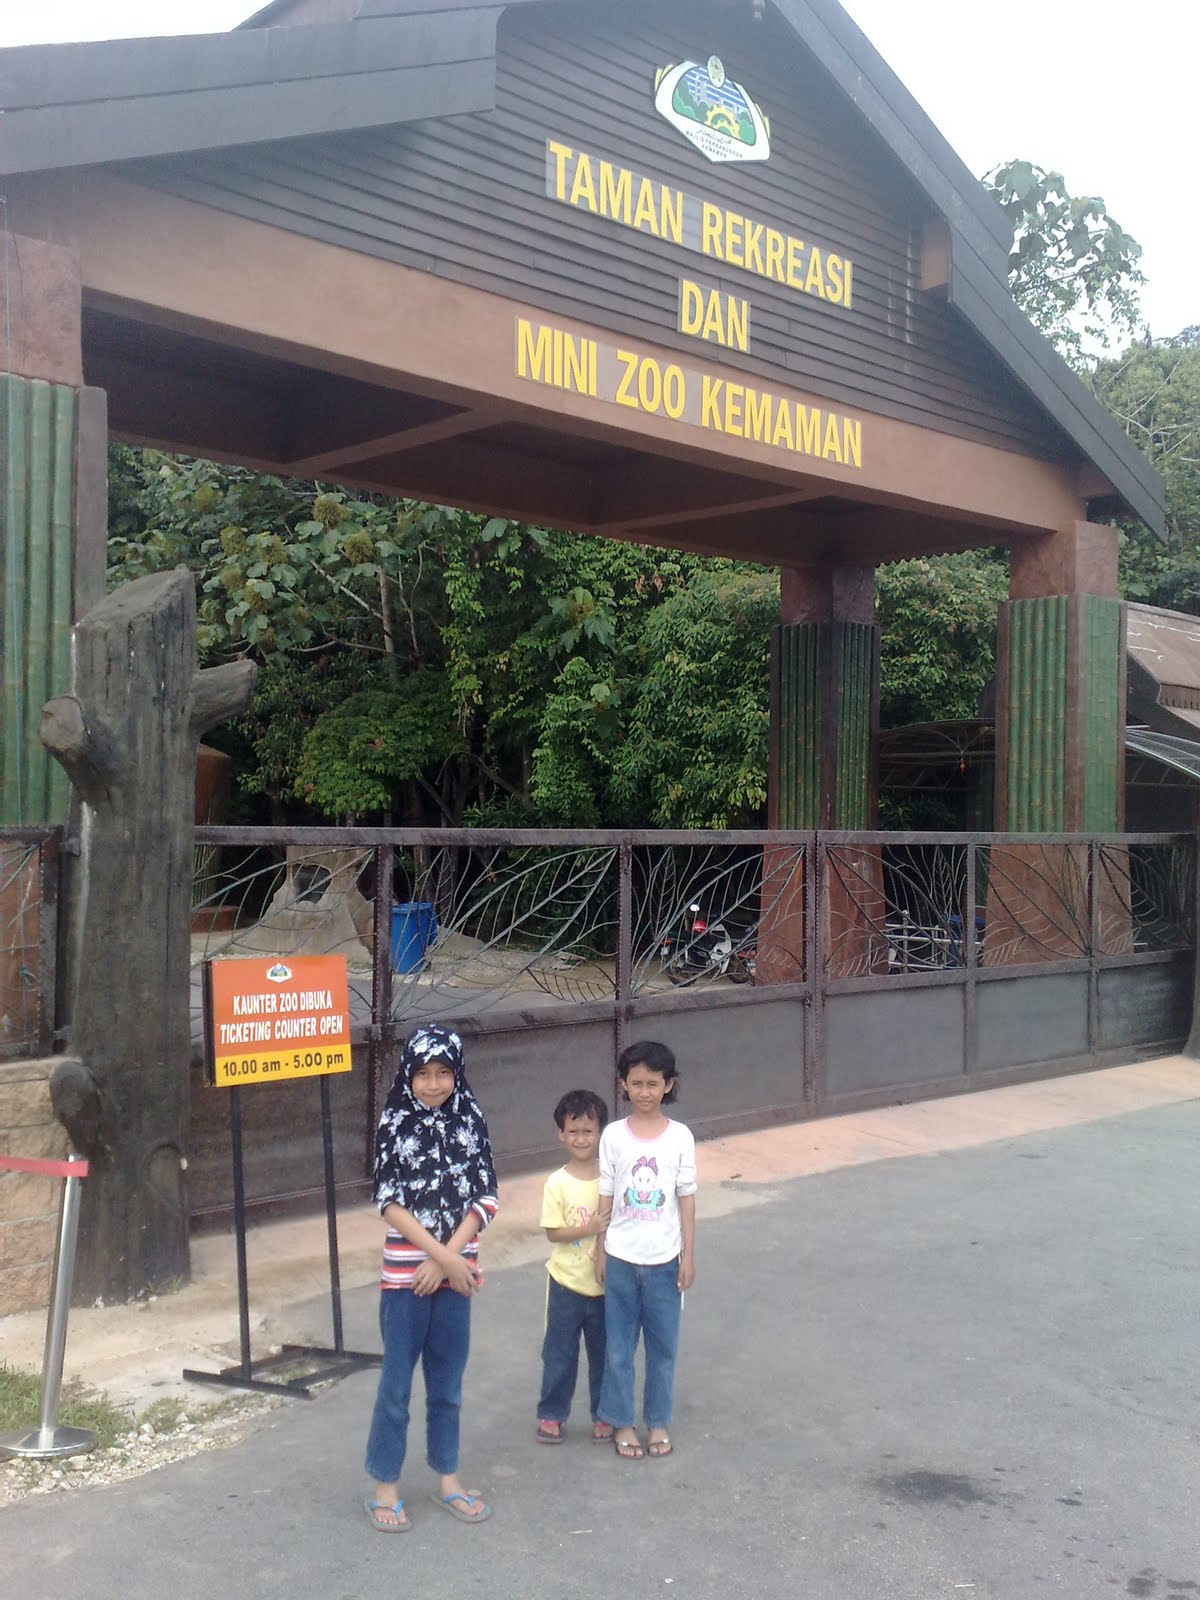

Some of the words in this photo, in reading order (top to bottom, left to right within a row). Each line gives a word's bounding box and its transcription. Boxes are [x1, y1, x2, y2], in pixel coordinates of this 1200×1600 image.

[549, 140, 683, 244] TAMAN
[702, 201, 852, 308] REKREASI
[681, 279, 748, 351] DAN
[517, 319, 597, 397] MINI
[616, 349, 685, 419] ZOO
[702, 375, 861, 467] KEMAMAN
[233, 993, 277, 1016] KAUNTER
[279, 992, 298, 1013] ZOO
[300, 990, 333, 1012] DIBUKA
[220, 1020, 271, 1044] TICKETING
[274, 1017, 317, 1040] COUNTER
[320, 1015, 343, 1036] OPEN
[223, 1059, 257, 1077] 10.00
[262, 1060, 281, 1072] am
[293, 1052, 322, 1069] 5.00
[326, 1053, 344, 1068] pm
